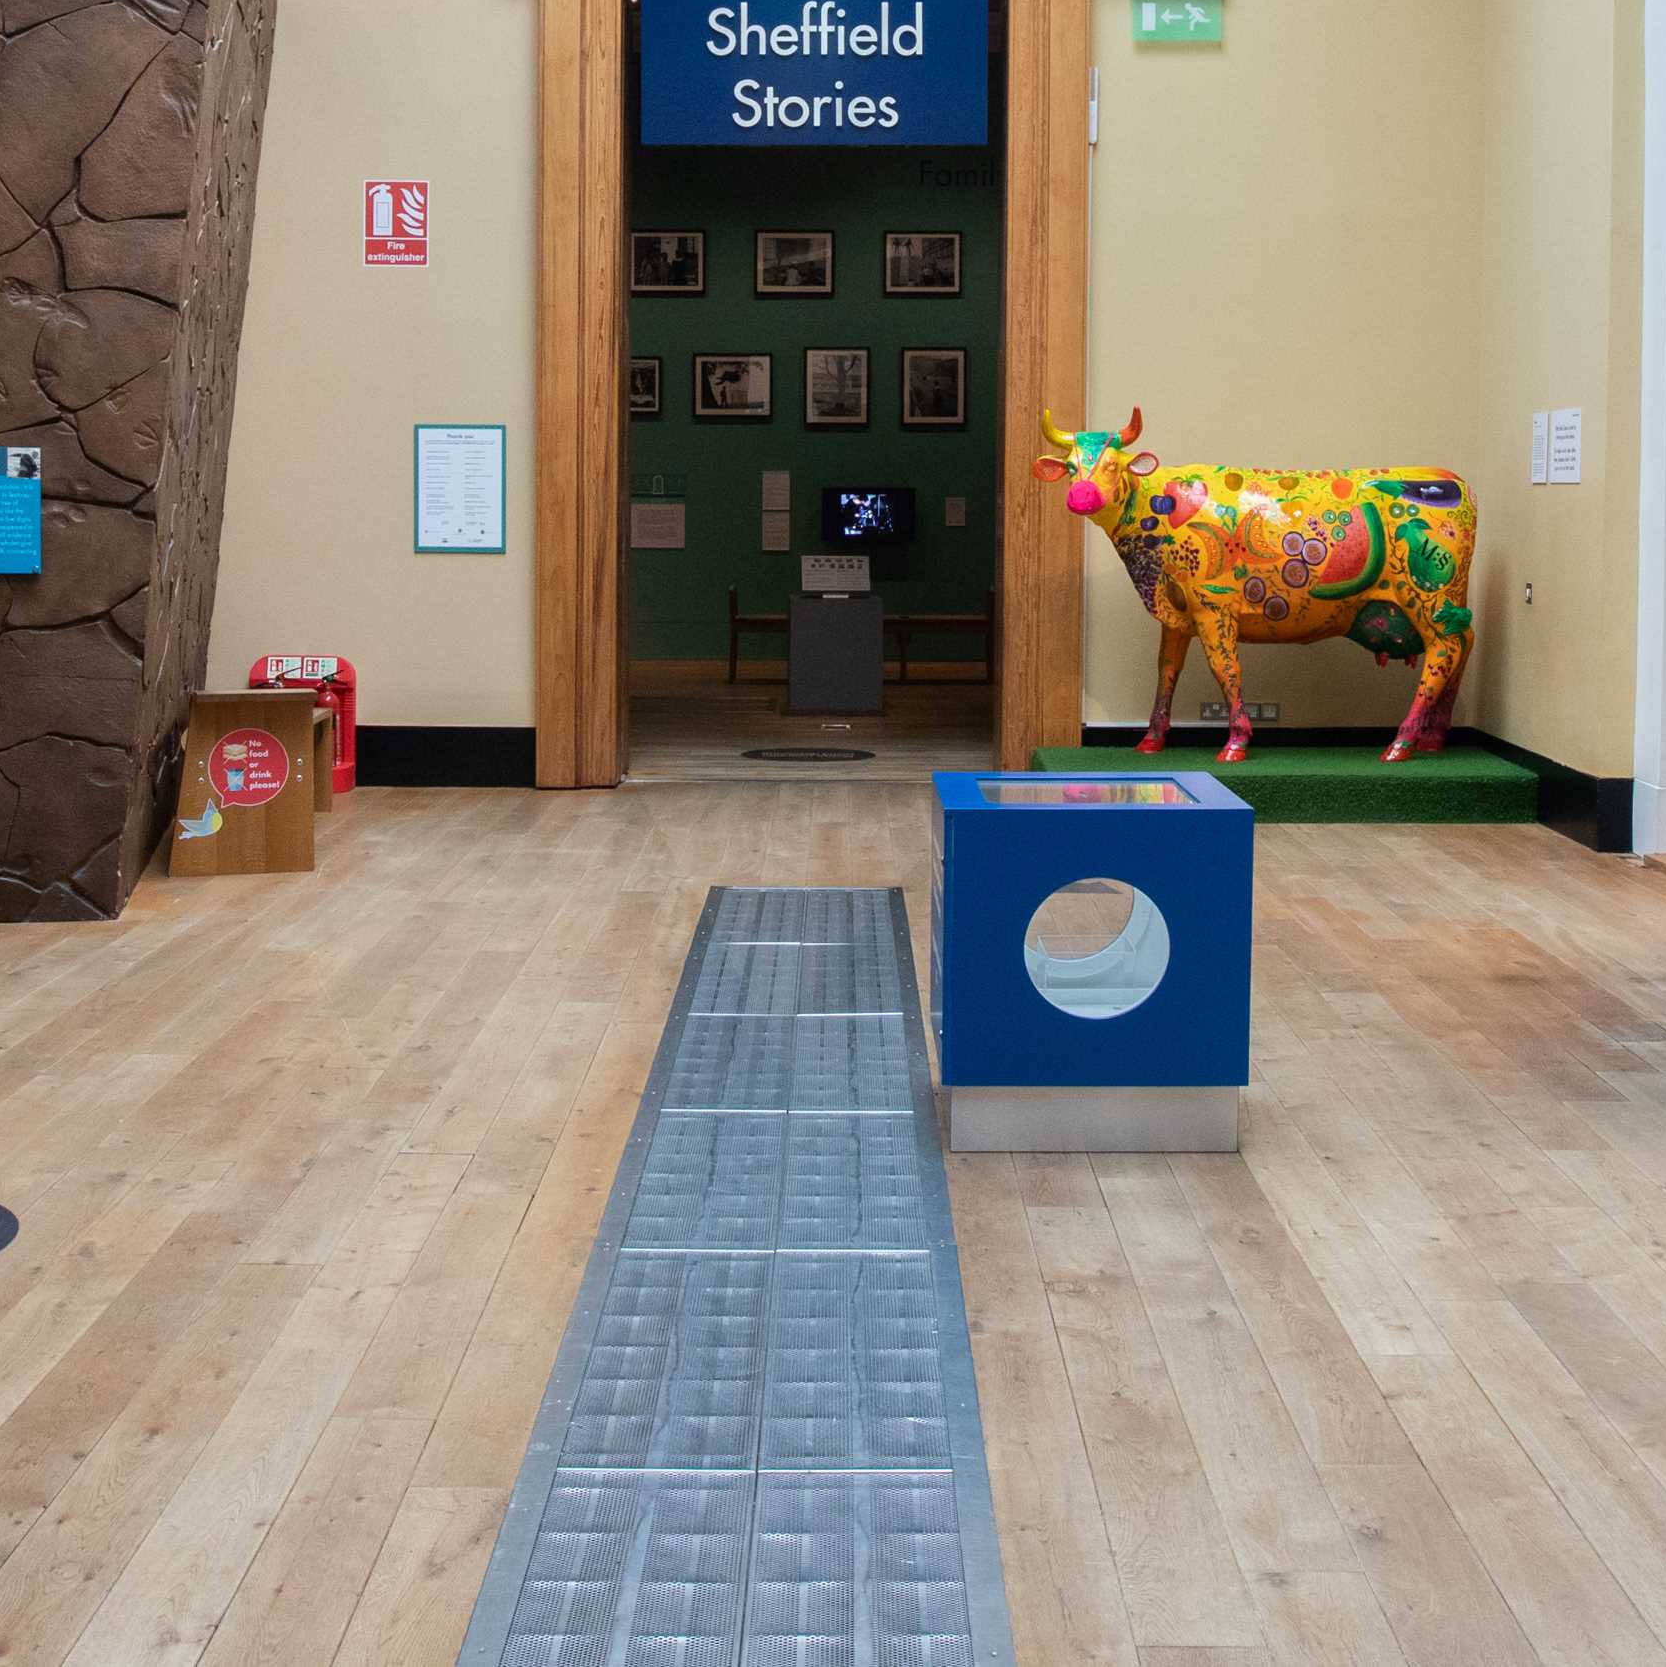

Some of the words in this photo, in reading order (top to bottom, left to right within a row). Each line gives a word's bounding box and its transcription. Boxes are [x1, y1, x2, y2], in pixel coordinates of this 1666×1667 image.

[706, 0, 924, 57] Sheffield
[732, 79, 900, 128] Stories
[386, 241, 406, 251] Fire
[367, 253, 425, 264] extinguisher
[248, 739, 262, 749] No
[248, 749, 270, 758] food
[248, 770, 272, 779] drink
[248, 780, 280, 792] please!
